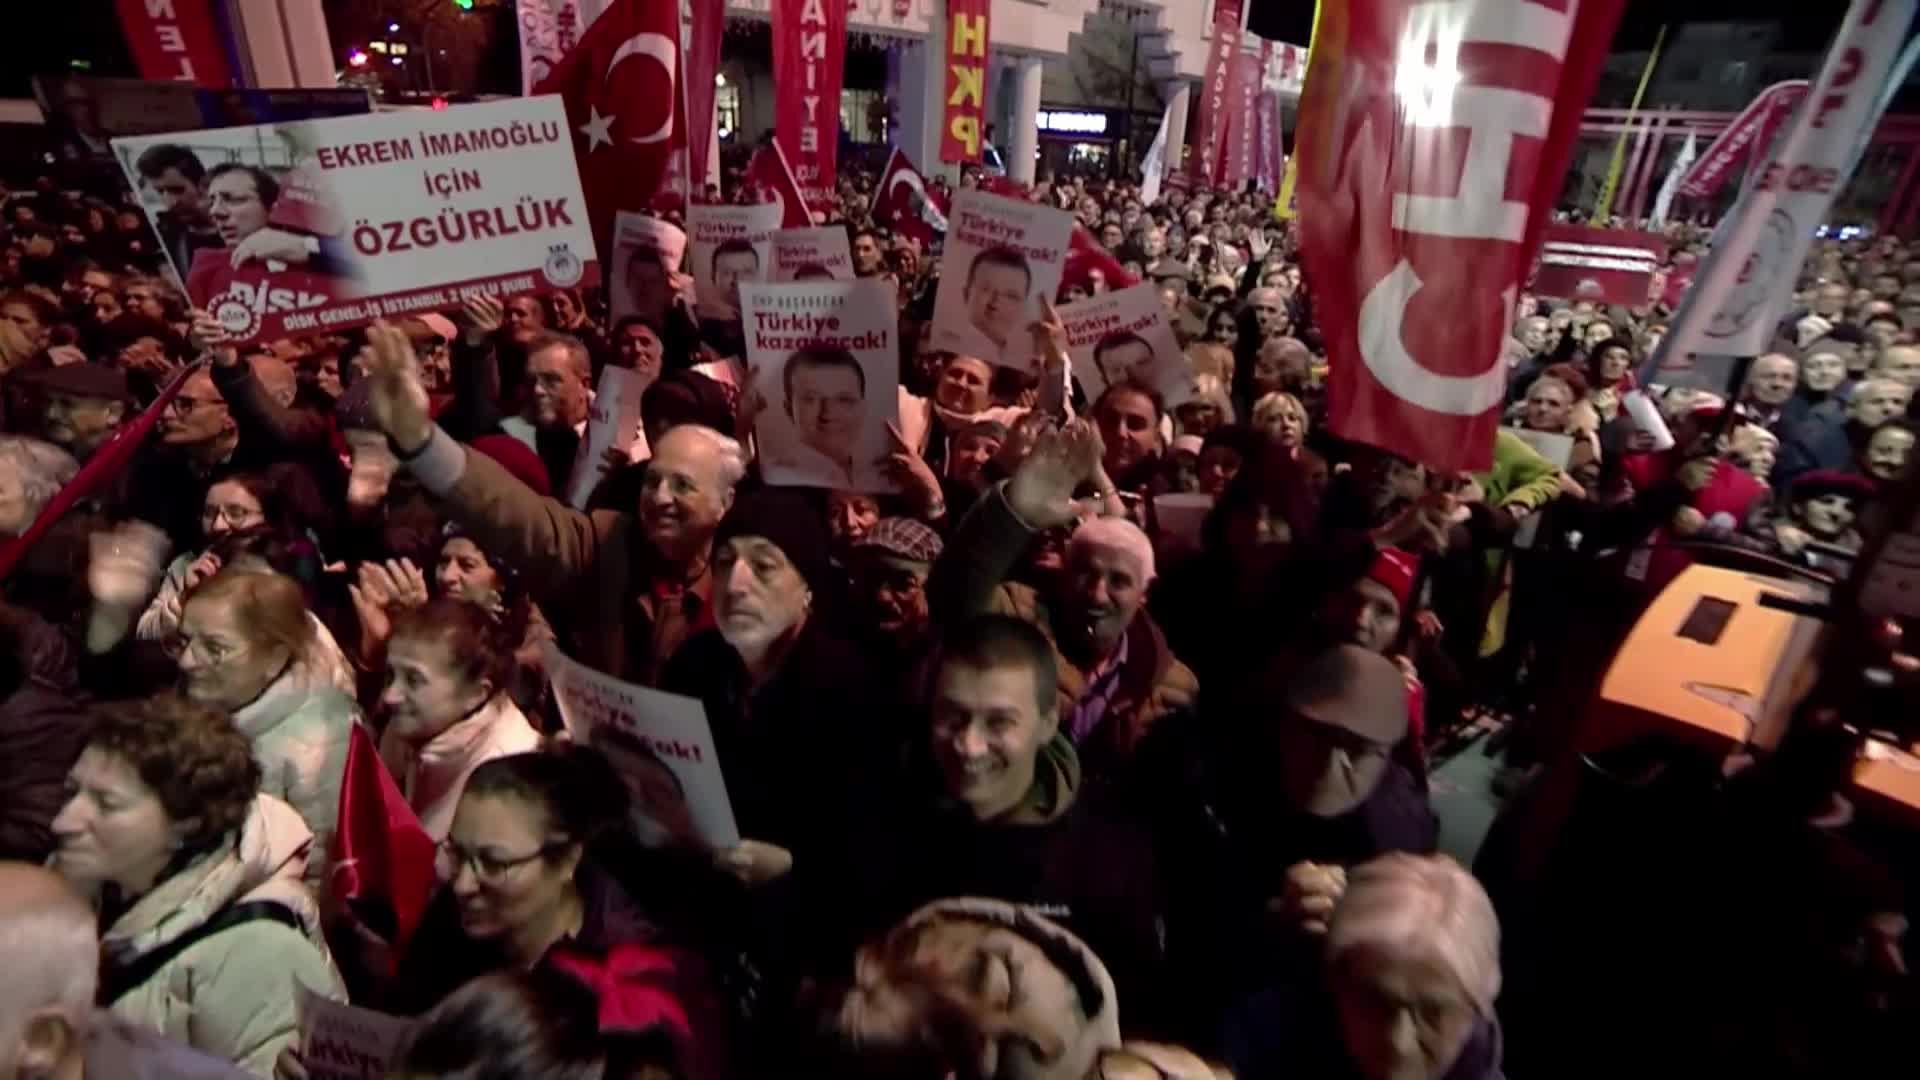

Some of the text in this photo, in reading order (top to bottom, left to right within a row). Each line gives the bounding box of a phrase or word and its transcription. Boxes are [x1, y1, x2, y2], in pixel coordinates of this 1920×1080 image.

[317, 119, 559, 169] EKREM İMAMOĞLU
[424, 168, 481, 199] İÇİN
[353, 196, 573, 256] ÖZGÜRLÜK
[961, 212, 1026, 241] Türkiye
[283, 313, 317, 332] DİSK
[384, 293, 447, 315] İSTANBUL
[755, 311, 841, 336] Türkiye
[1064, 314, 1121, 336] Türkiye
[756, 329, 888, 351] kazanacak!
